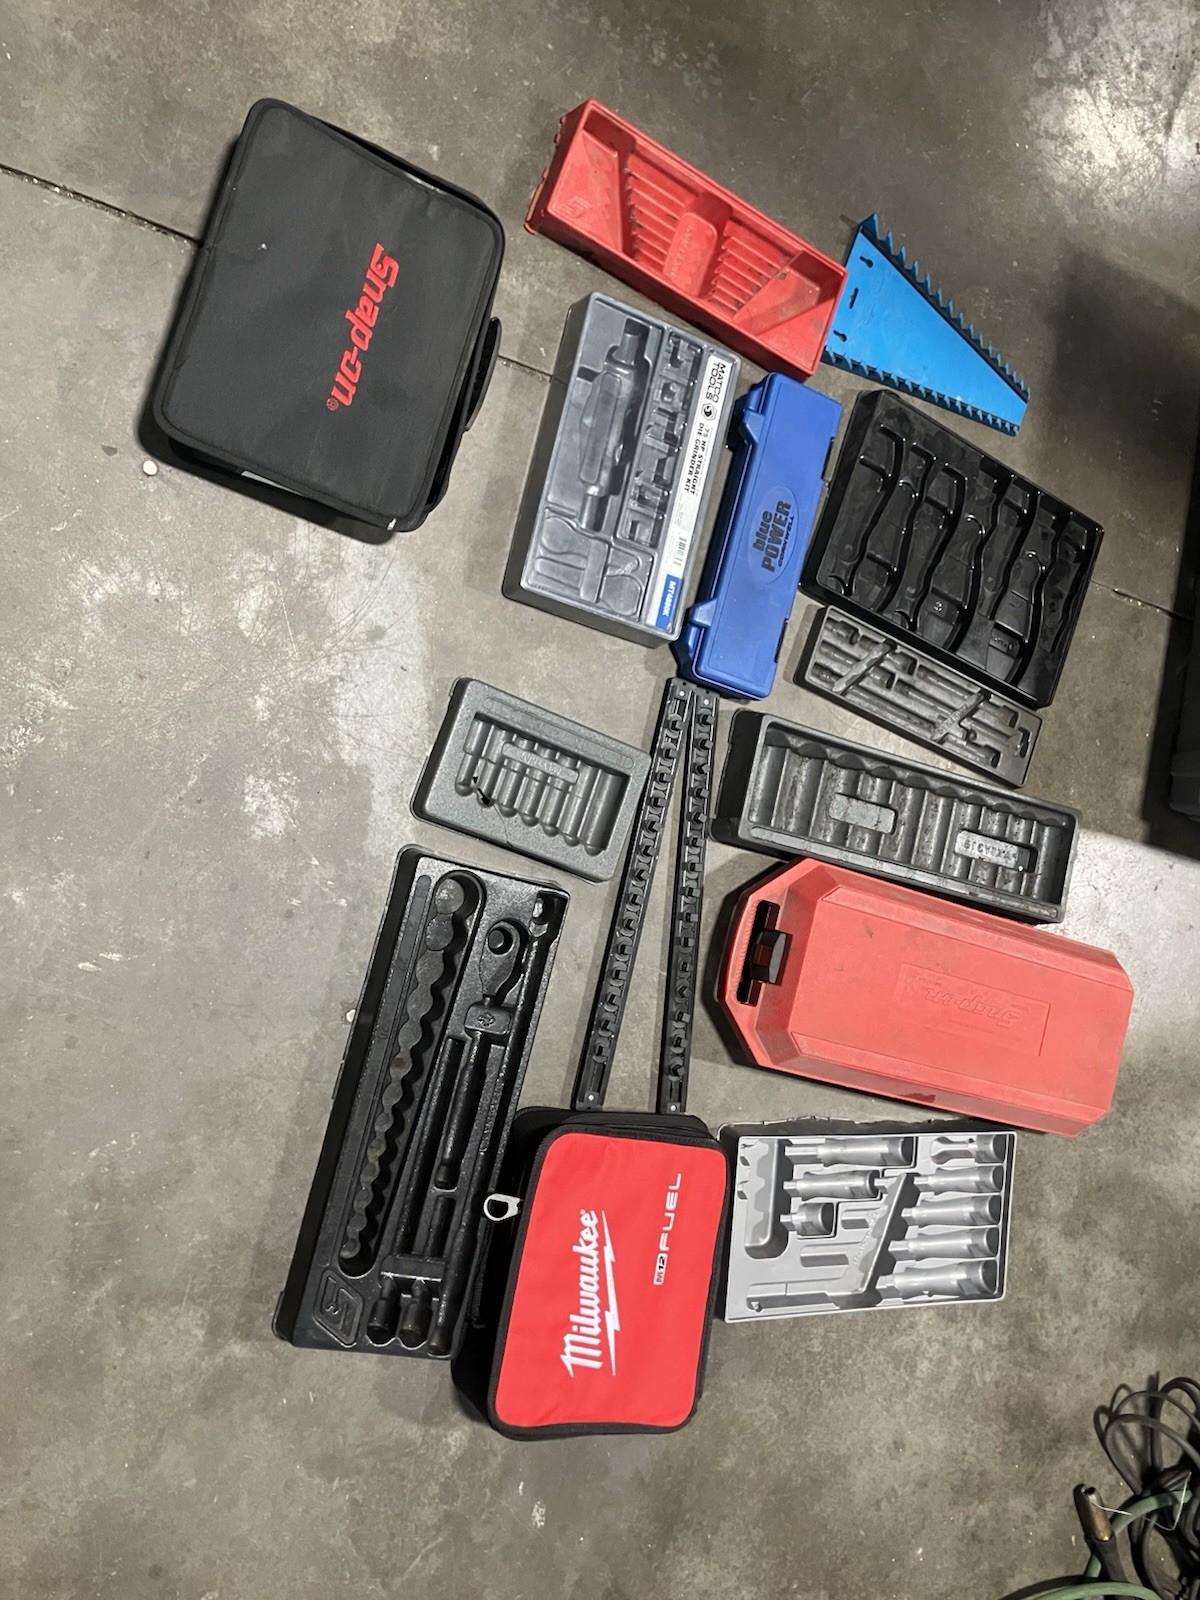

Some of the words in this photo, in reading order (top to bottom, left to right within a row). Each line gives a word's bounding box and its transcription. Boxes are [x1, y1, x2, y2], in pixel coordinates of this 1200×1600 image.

[706, 362, 720, 400] TOOLS
[712, 363, 726, 403] MATCO
[697, 422, 705, 437] DIE
[687, 439, 700, 476] GRINDER
[690, 454, 703, 496] STRAIGHT
[684, 477, 692, 493] KIT
[752, 510, 773, 551] blue
[761, 500, 792, 572] POWER
[778, 515, 794, 567] CORNWELL
[659, 1173, 682, 1251] FUEL
[655, 1255, 667, 1283] M12
[560, 1209, 603, 1377] Milwaukee
